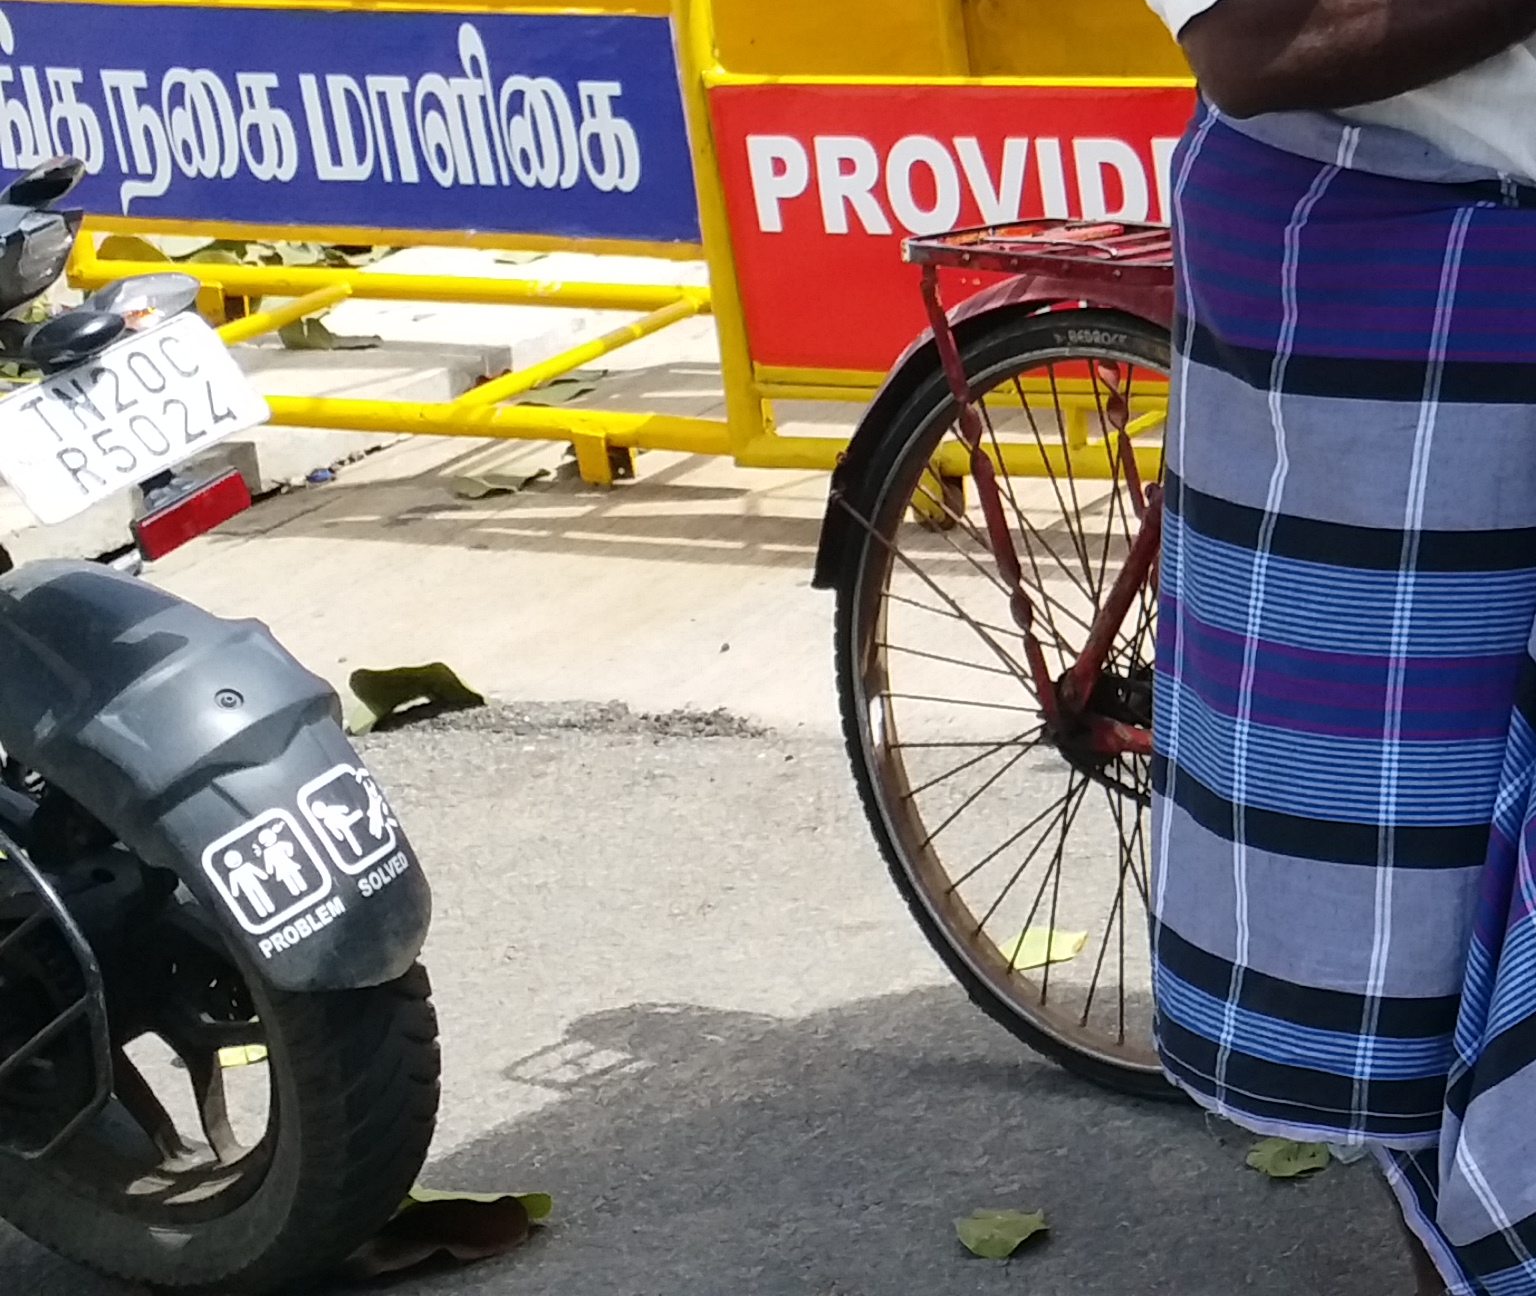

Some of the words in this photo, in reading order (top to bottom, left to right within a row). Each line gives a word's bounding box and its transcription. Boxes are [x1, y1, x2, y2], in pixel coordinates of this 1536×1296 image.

[100, 66, 298, 216] நகை
[299, 22, 641, 193] மாளிகை
[745, 133, 1175, 237] PROVID
[19, 336, 200, 442] TN20C
[55, 379, 238, 495] R5024
[356, 850, 410, 898] SOLVED
[257, 895, 346, 960] PROBLEM
